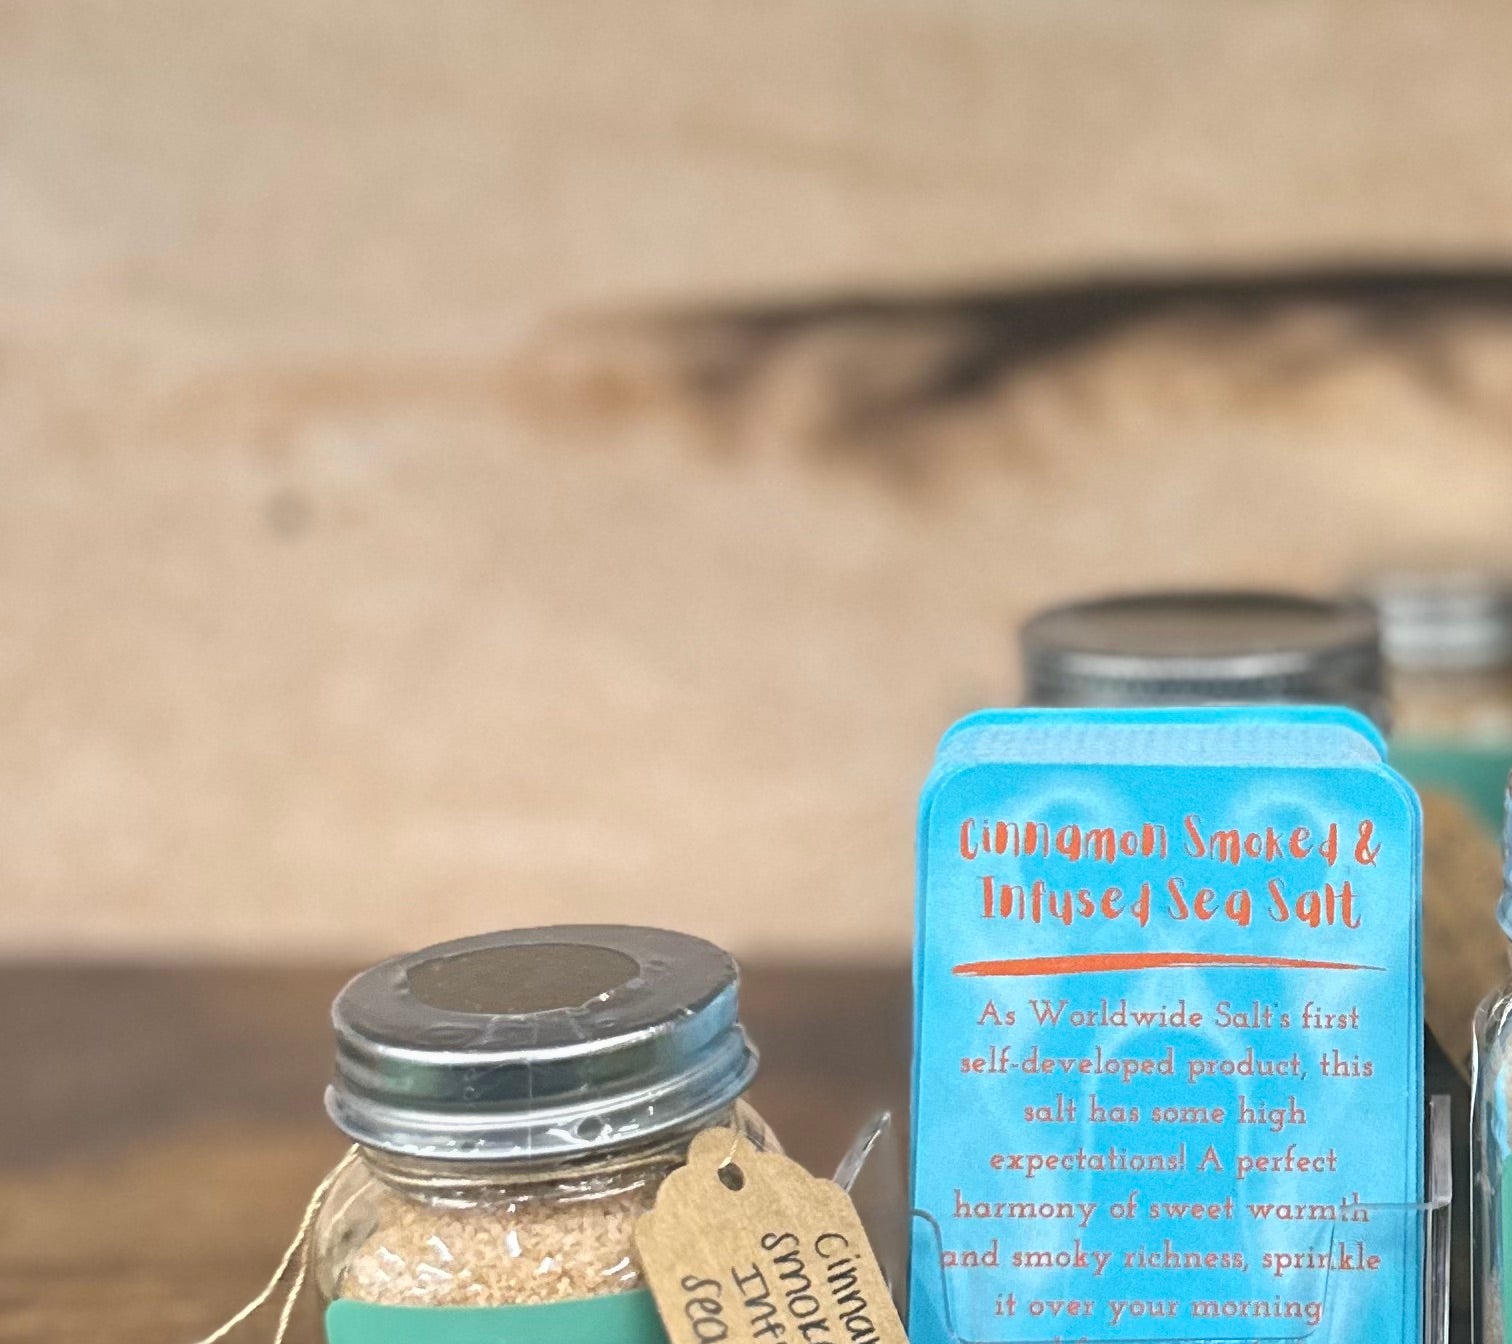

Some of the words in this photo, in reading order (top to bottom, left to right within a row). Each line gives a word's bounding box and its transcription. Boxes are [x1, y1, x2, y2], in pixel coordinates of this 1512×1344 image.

[958, 815, 1169, 866] Cinnamon
[1182, 816, 1340, 868] Smoked
[1353, 816, 1383, 867] &
[980, 874, 1153, 929] Infused
[1165, 874, 1253, 929] Sea
[1265, 877, 1362, 930] Salt
[977, 1000, 1017, 1027] As
[1029, 1000, 1204, 1029] Worldwide
[1215, 999, 1292, 1030] Salt's
[1301, 1002, 1360, 1030] first
[959, 1045, 1177, 1082] self-developed
[1186, 1048, 1308, 1086] product,
[1319, 1049, 1375, 1079] this
[1023, 1093, 1077, 1124] salt
[1087, 1093, 1142, 1126] has
[1149, 1104, 1227, 1126] some
[1237, 1097, 1307, 1133] high
[988, 1142, 1188, 1179] expectations!
[1197, 1143, 1225, 1174] A
[1235, 1144, 1338, 1183] perfect
[952, 1188, 1099, 1229] harmony
[1108, 1189, 1141, 1222] of
[1148, 1196, 1235, 1222] sweet
[1247, 1191, 1371, 1224] warmth
[938, 1241, 1000, 1271] and
[1011, 1239, 1111, 1279] smoky
[1123, 1243, 1249, 1273] richness,
[1262, 1242, 1383, 1279] sprinkle
[994, 1294, 1018, 1317] it
[1027, 1298, 1096, 1318] over
[1108, 1298, 1181, 1327] your
[1189, 1294, 1324, 1327] morning
